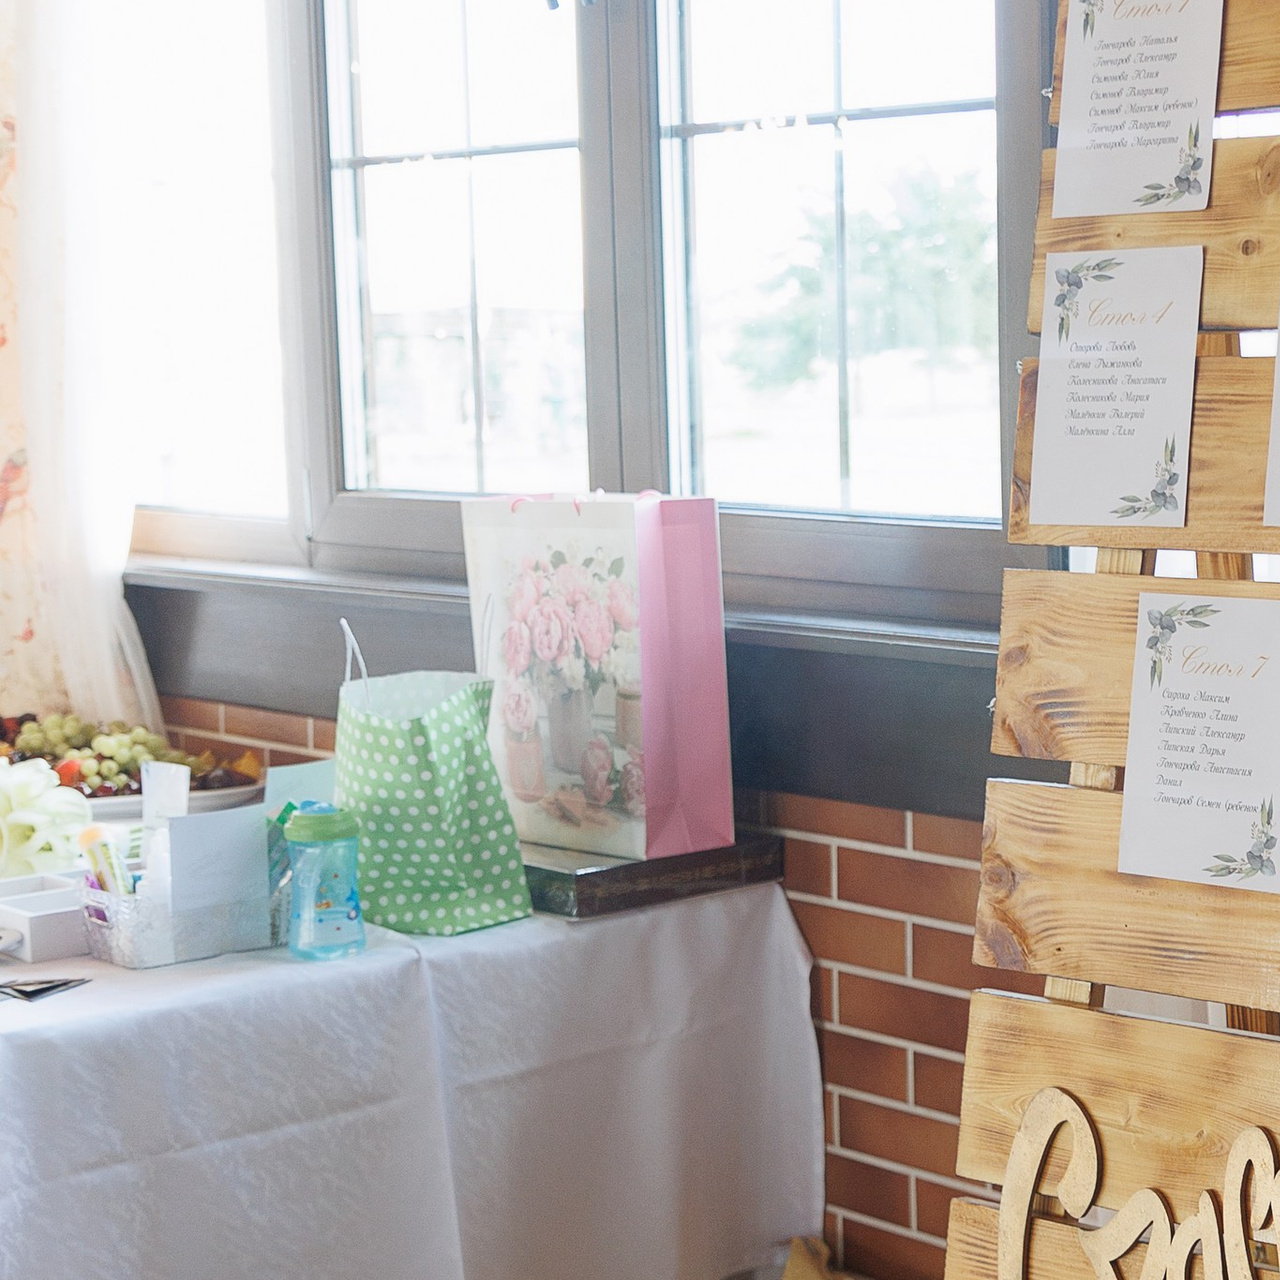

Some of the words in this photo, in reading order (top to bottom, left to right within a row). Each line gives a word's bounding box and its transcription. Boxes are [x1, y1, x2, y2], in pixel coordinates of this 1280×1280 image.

[1087, 298, 1148, 327] Стол
[1120, 392, 1150, 404] Мария
[1181, 645, 1246, 678] Стол
[1250, 656, 1271, 679] 7
[1162, 687, 1191, 701] Садоха
[1194, 691, 1230, 704] Максим
[1160, 705, 1206, 720] Кравченко
[1209, 709, 1238, 722] Алина
[1199, 726, 1246, 742] Александр
[1198, 743, 1226, 757] Дарья
[1156, 757, 1201, 774] Гончарова
[1204, 762, 1253, 777] Анастасия
[1155, 775, 1182, 787] Данил
[1153, 792, 1194, 806] Гончаров
[1196, 796, 1221, 809] Семен
